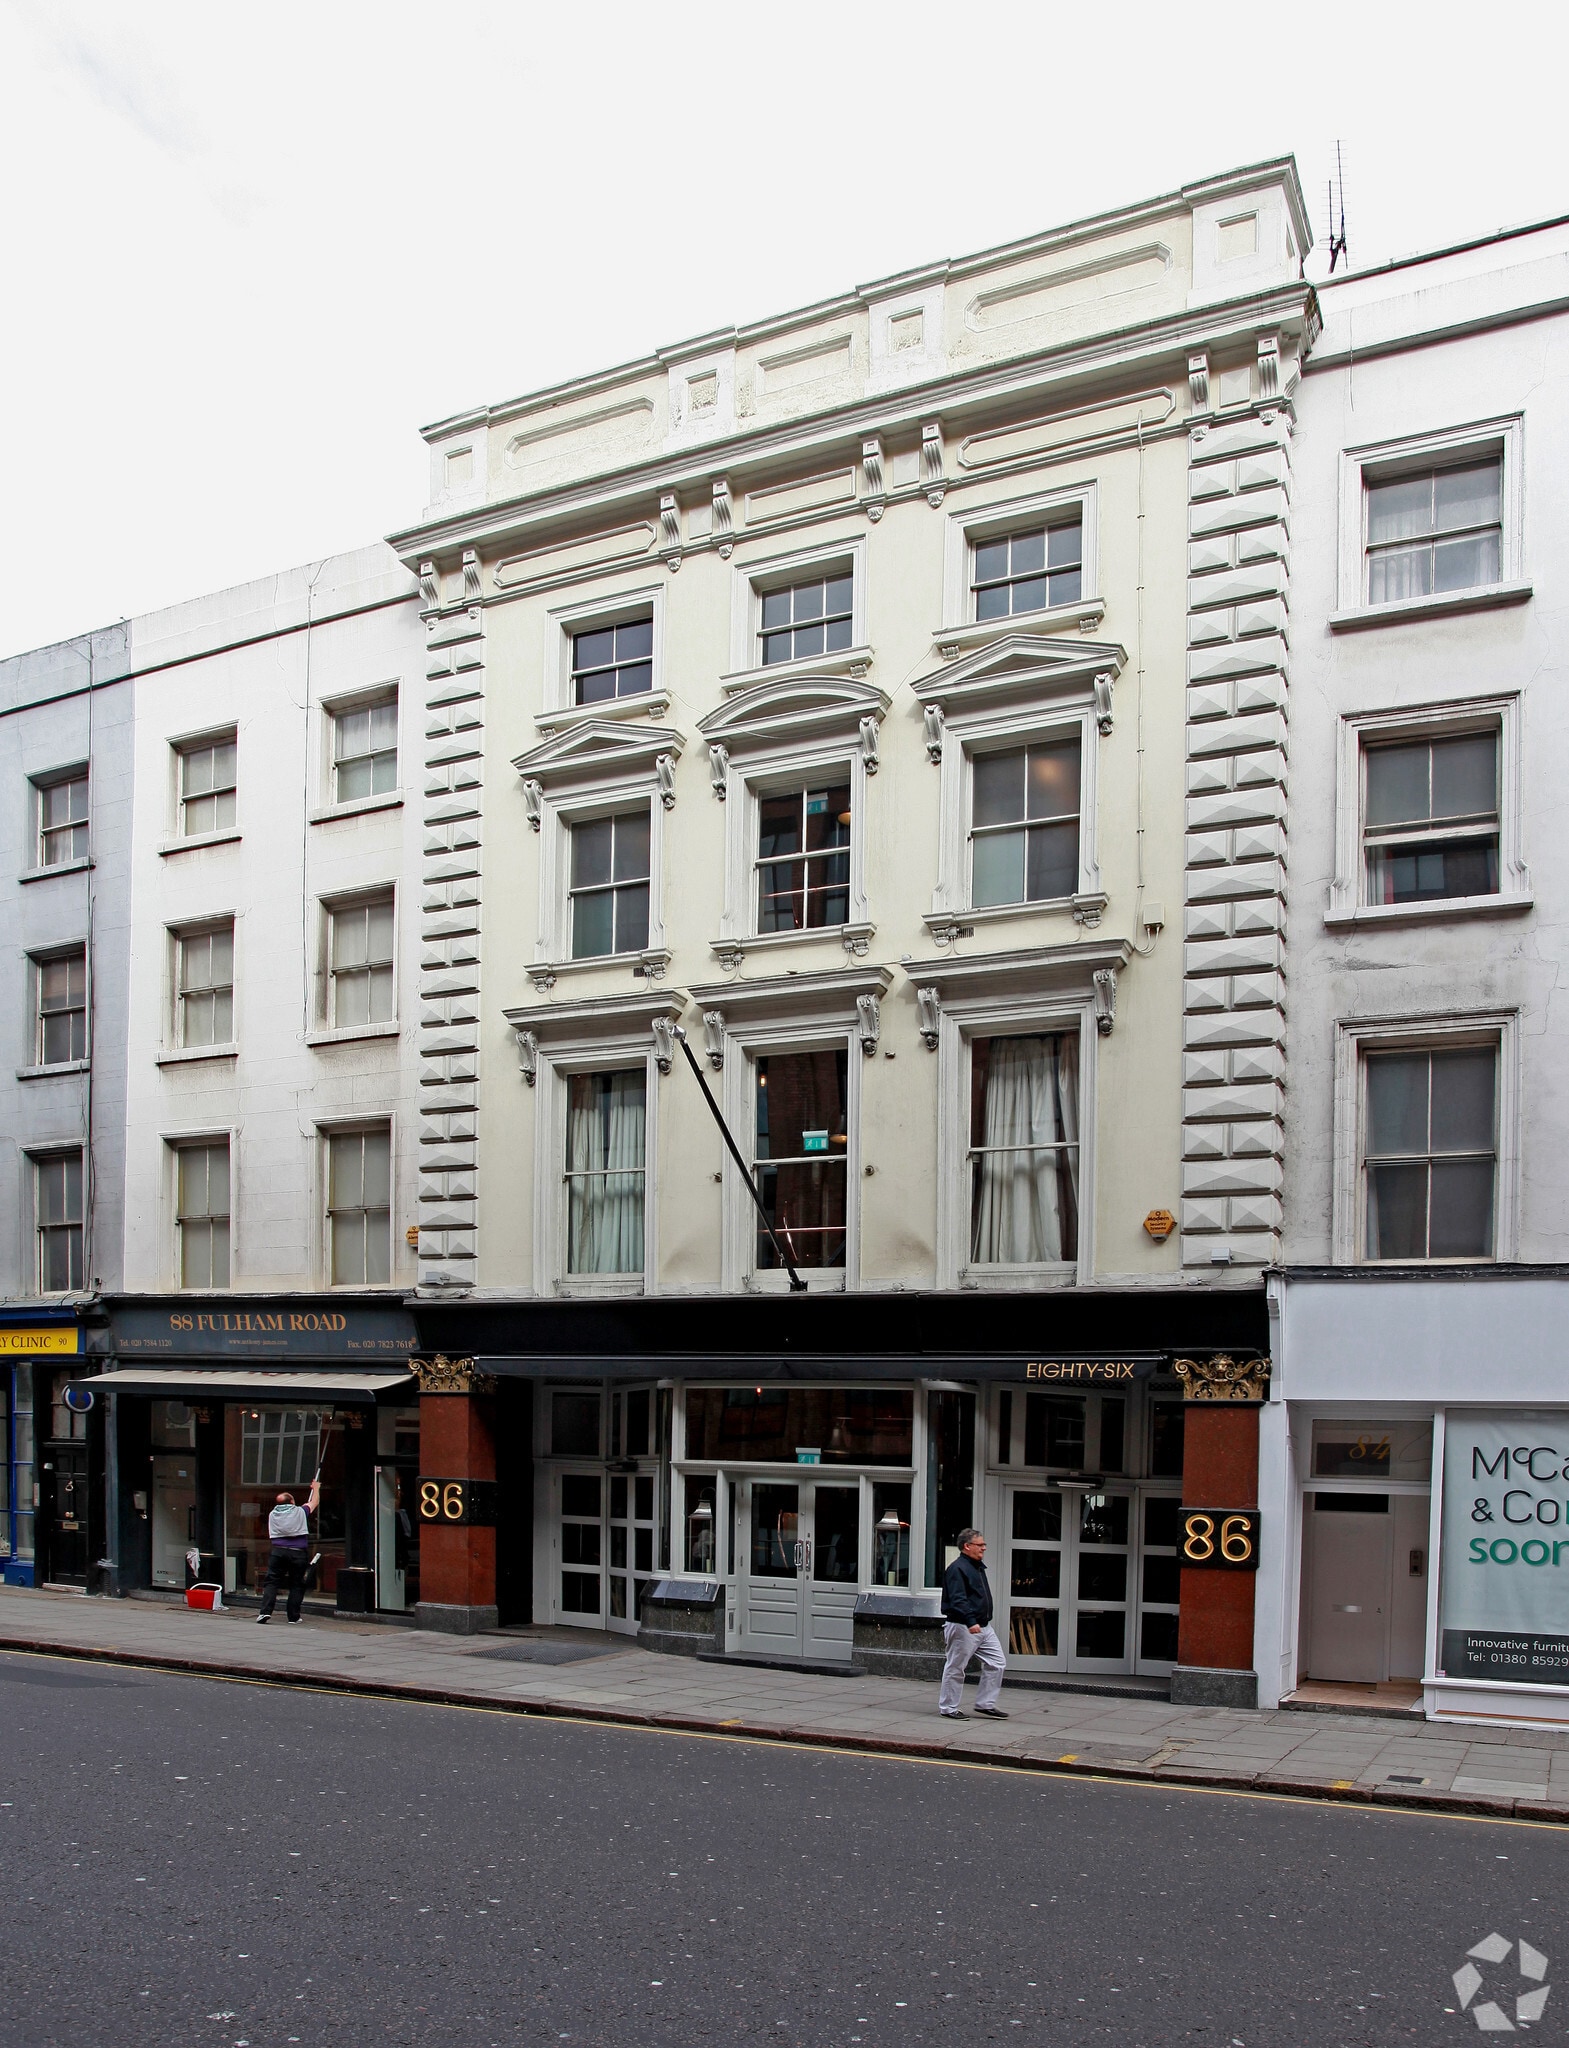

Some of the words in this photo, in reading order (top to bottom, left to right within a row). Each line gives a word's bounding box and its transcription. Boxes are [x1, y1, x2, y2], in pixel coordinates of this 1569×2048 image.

[169, 1313, 194, 1331] 88
[196, 1313, 286, 1331] FULHAM
[289, 1313, 347, 1331] ROAD
[11, 1335, 52, 1348] CLINIC
[58, 1337, 68, 1346] 90
[362, 1340, 376, 1349] 020
[377, 1340, 395, 1349] 7823
[395, 1340, 413, 1349] 7618
[1026, 1362, 1136, 1379] EIGHTY-SIX
[1348, 1434, 1393, 1461] 84
[420, 1481, 464, 1519] 86
[1471, 1497, 1495, 1523] &
[1183, 1513, 1252, 1562] 86
[1467, 1637, 1529, 1651] Innovative
[1466, 1651, 1487, 1662] Tel:
[1490, 1653, 1527, 1665] 01380
[1531, 1655, 1569, 1667] 85929
